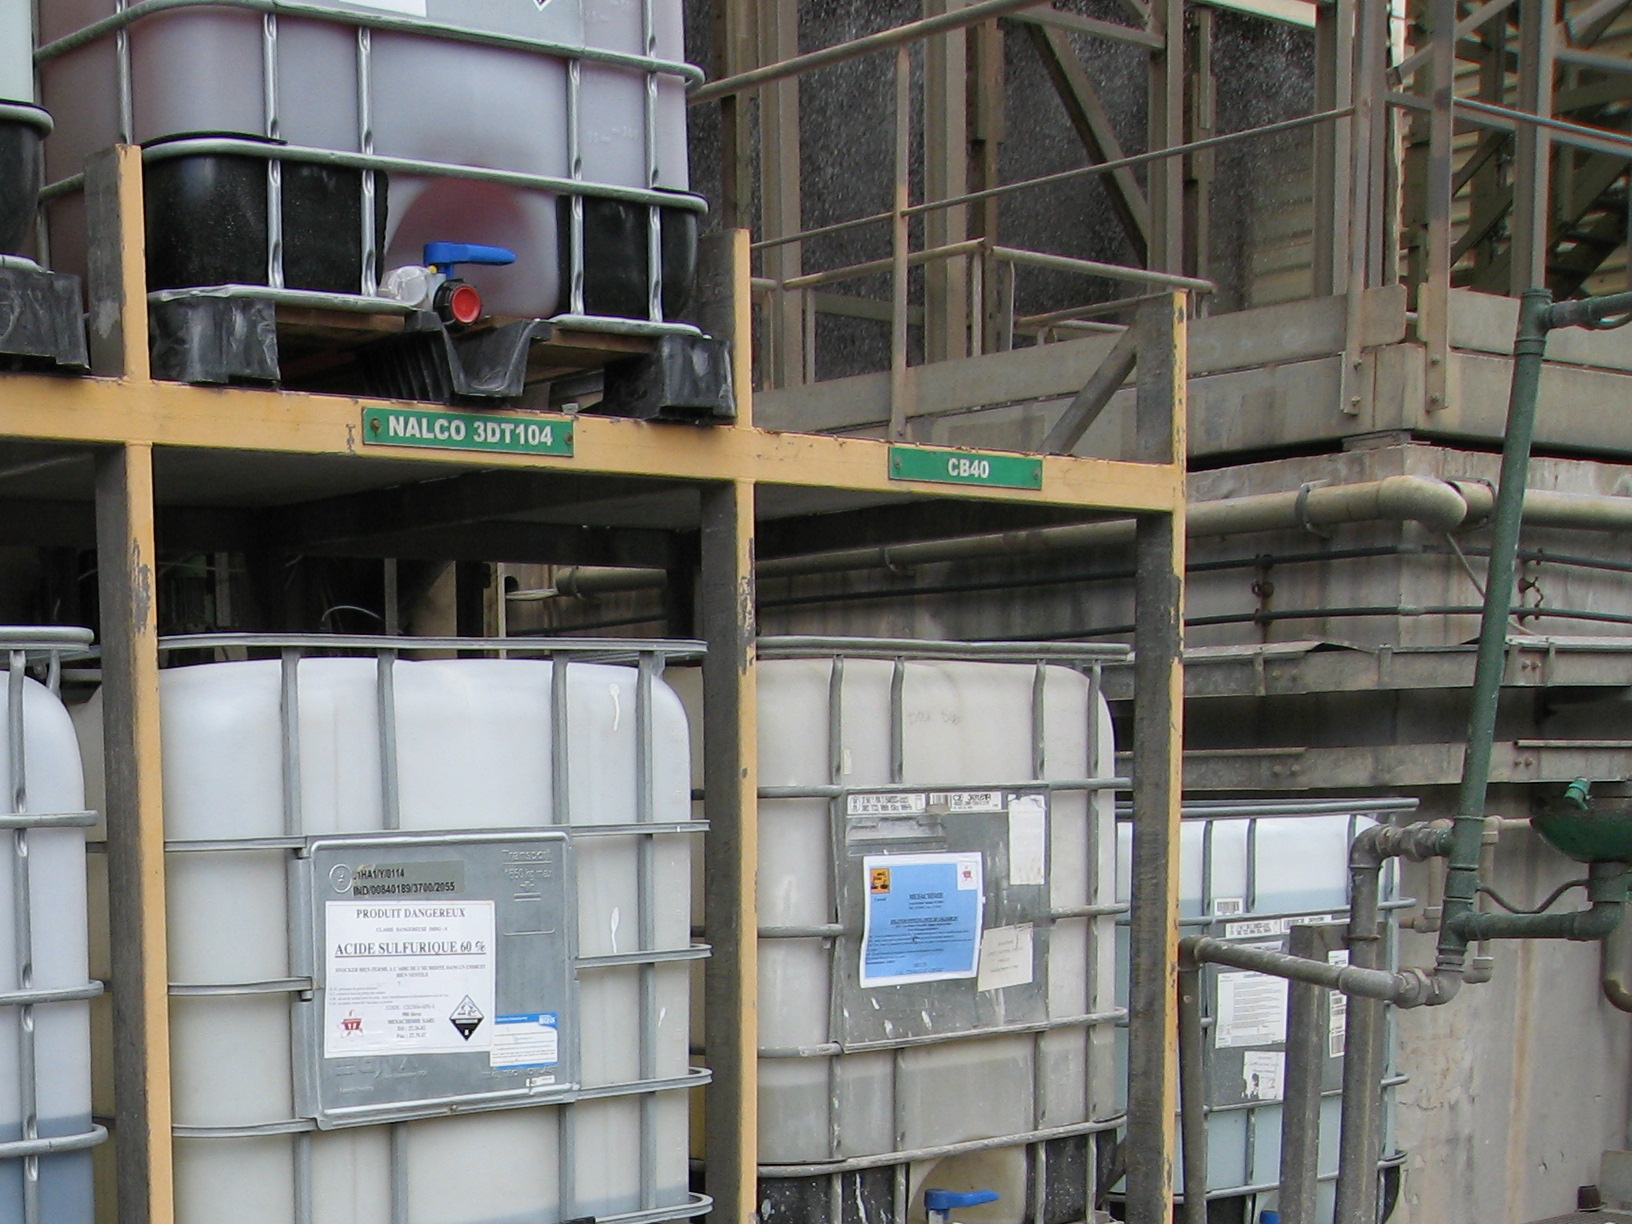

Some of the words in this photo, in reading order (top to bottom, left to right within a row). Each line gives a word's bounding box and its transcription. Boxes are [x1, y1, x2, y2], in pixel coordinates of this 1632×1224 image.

[388, 415, 467, 441] NALCO
[473, 420, 553, 446] 3DT104
[948, 457, 990, 479] CB40
[356, 908, 402, 919] PRODUIT
[403, 907, 466, 918] DANGEREUX
[335, 942, 376, 955] ACIDE
[378, 940, 458, 954] SULFURIQUE
[460, 940, 472, 953] 60
